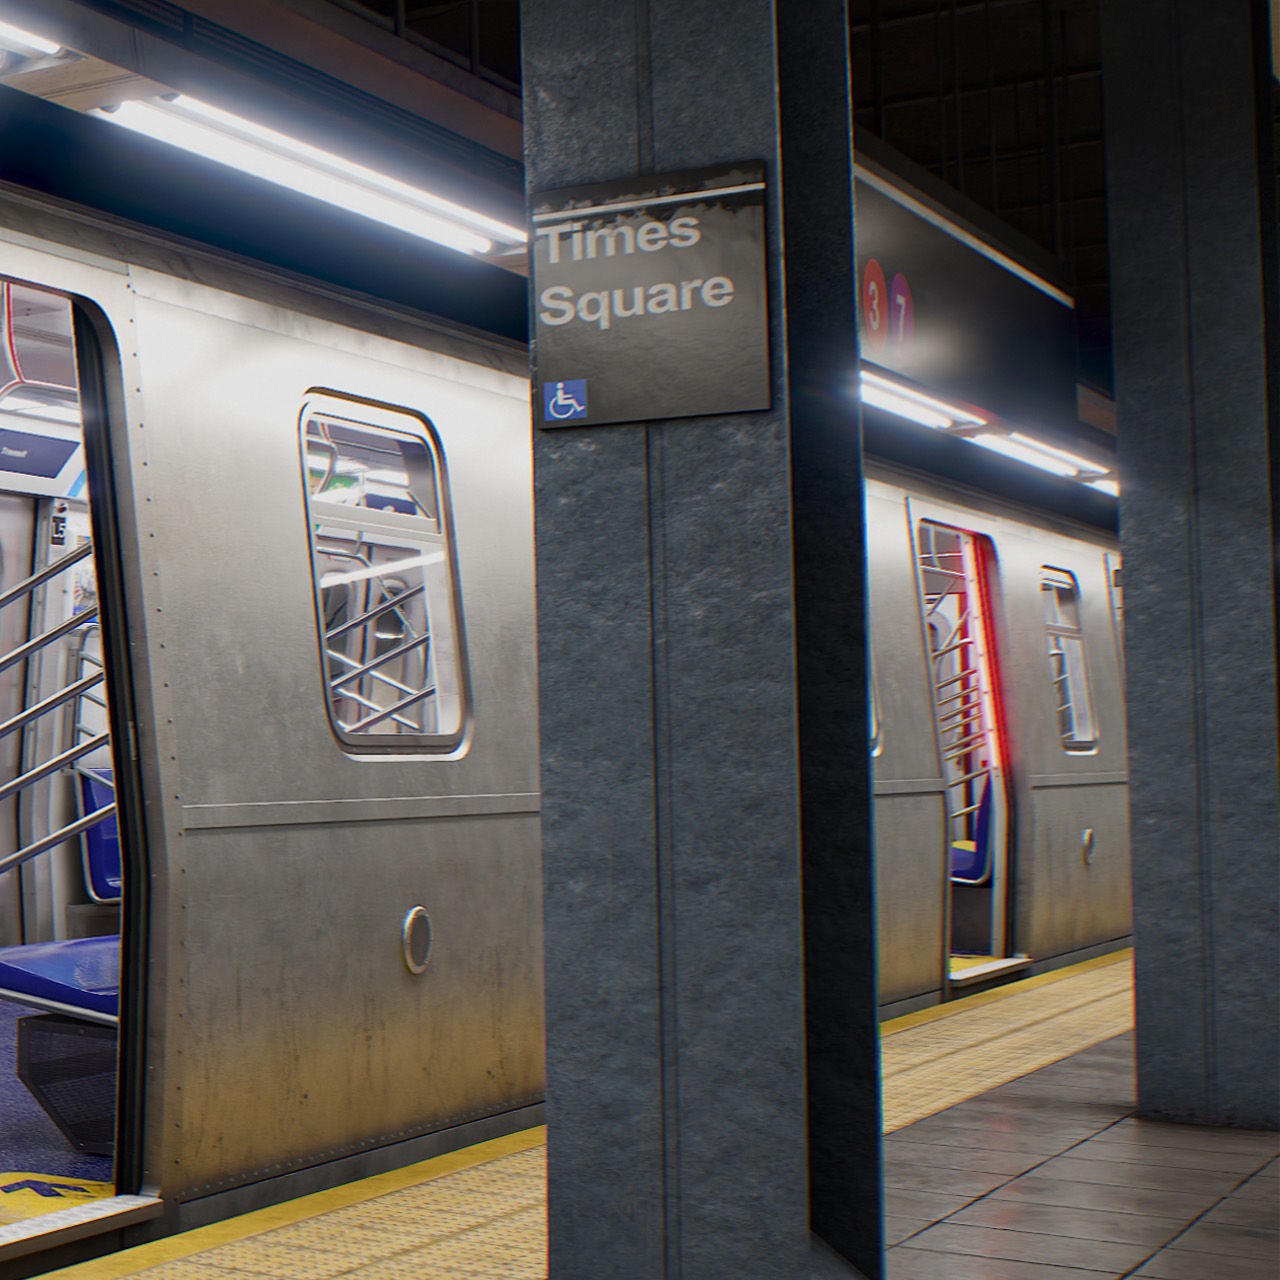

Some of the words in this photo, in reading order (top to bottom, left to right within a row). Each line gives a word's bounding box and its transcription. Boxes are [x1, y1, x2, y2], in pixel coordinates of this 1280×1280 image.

[536, 217, 703, 264] Times
[540, 276, 735, 330] Square
[868, 280, 880, 331] 3
[896, 294, 907, 340] 7
